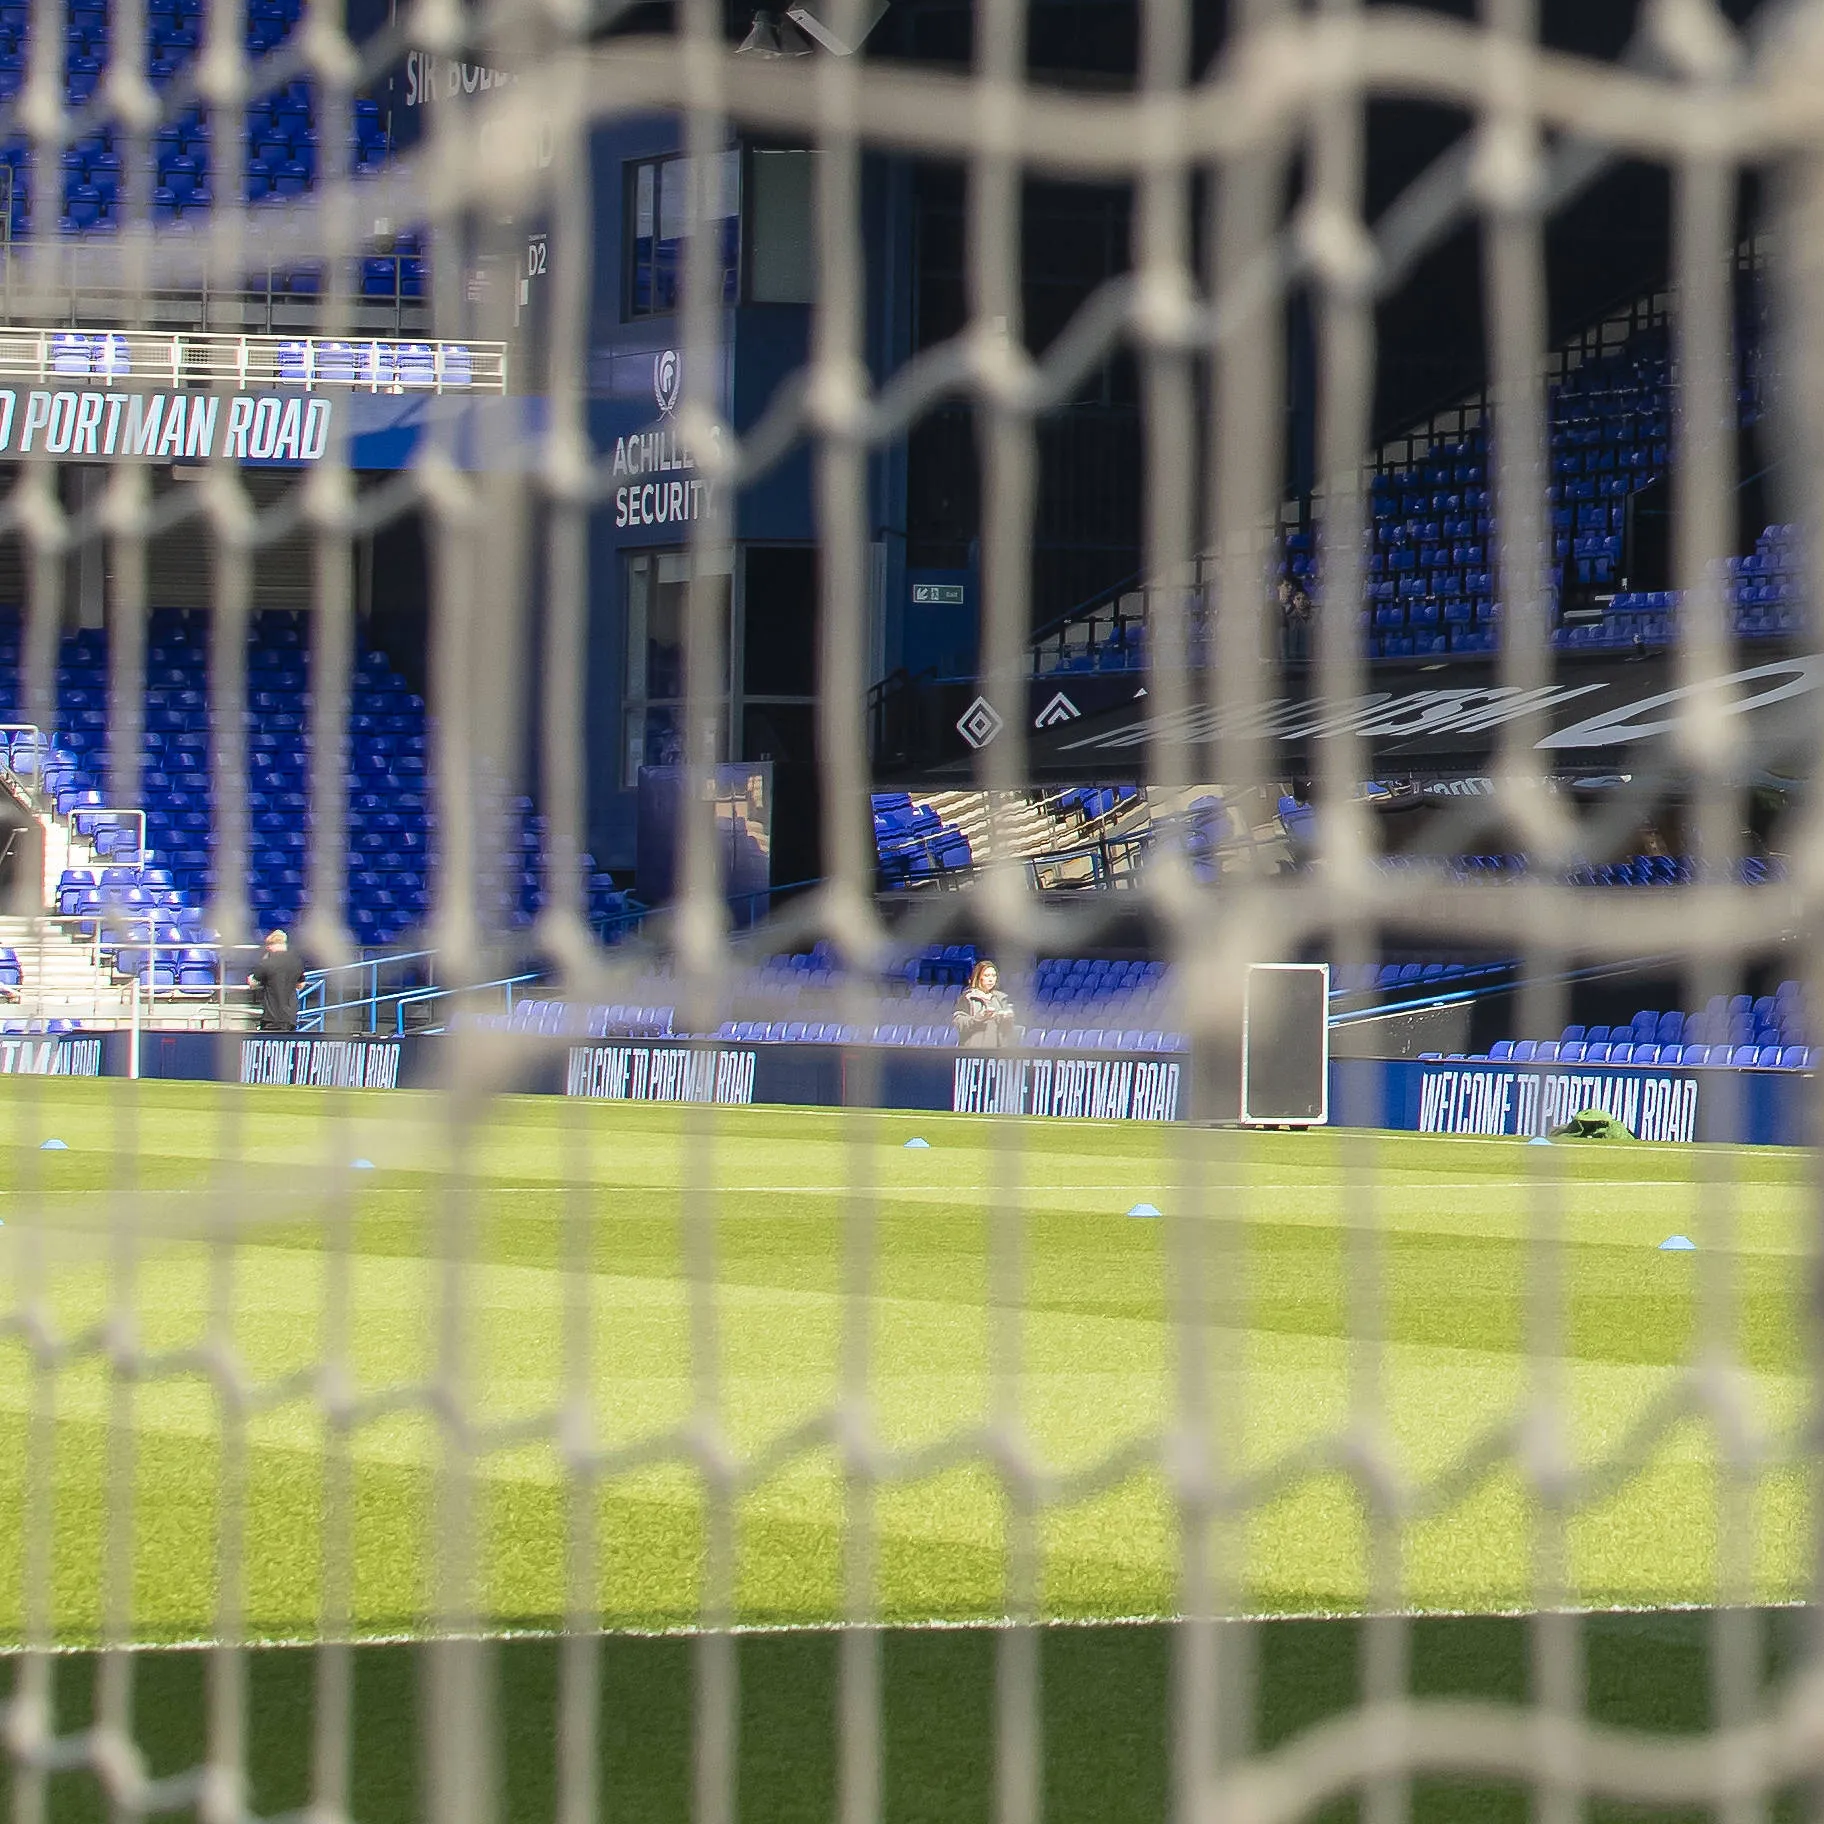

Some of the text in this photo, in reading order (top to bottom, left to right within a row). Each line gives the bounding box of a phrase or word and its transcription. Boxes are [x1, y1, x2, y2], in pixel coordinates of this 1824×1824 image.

[528, 242, 547, 276] D2
[19, 390, 220, 457] PORTMAN
[222, 396, 333, 460] ROAD
[615, 479, 716, 528] SECURITY
[241, 1040, 400, 1088] WELCOME TO PORTMAN ROAD
[567, 1047, 756, 1104] WELCOME TO PORTMAN ROAD
[953, 1057, 1180, 1121] WELCOME TO PORTMAN ROAD
[1419, 1071, 1698, 1143] WELCOME TO PORTMAN ROAD
